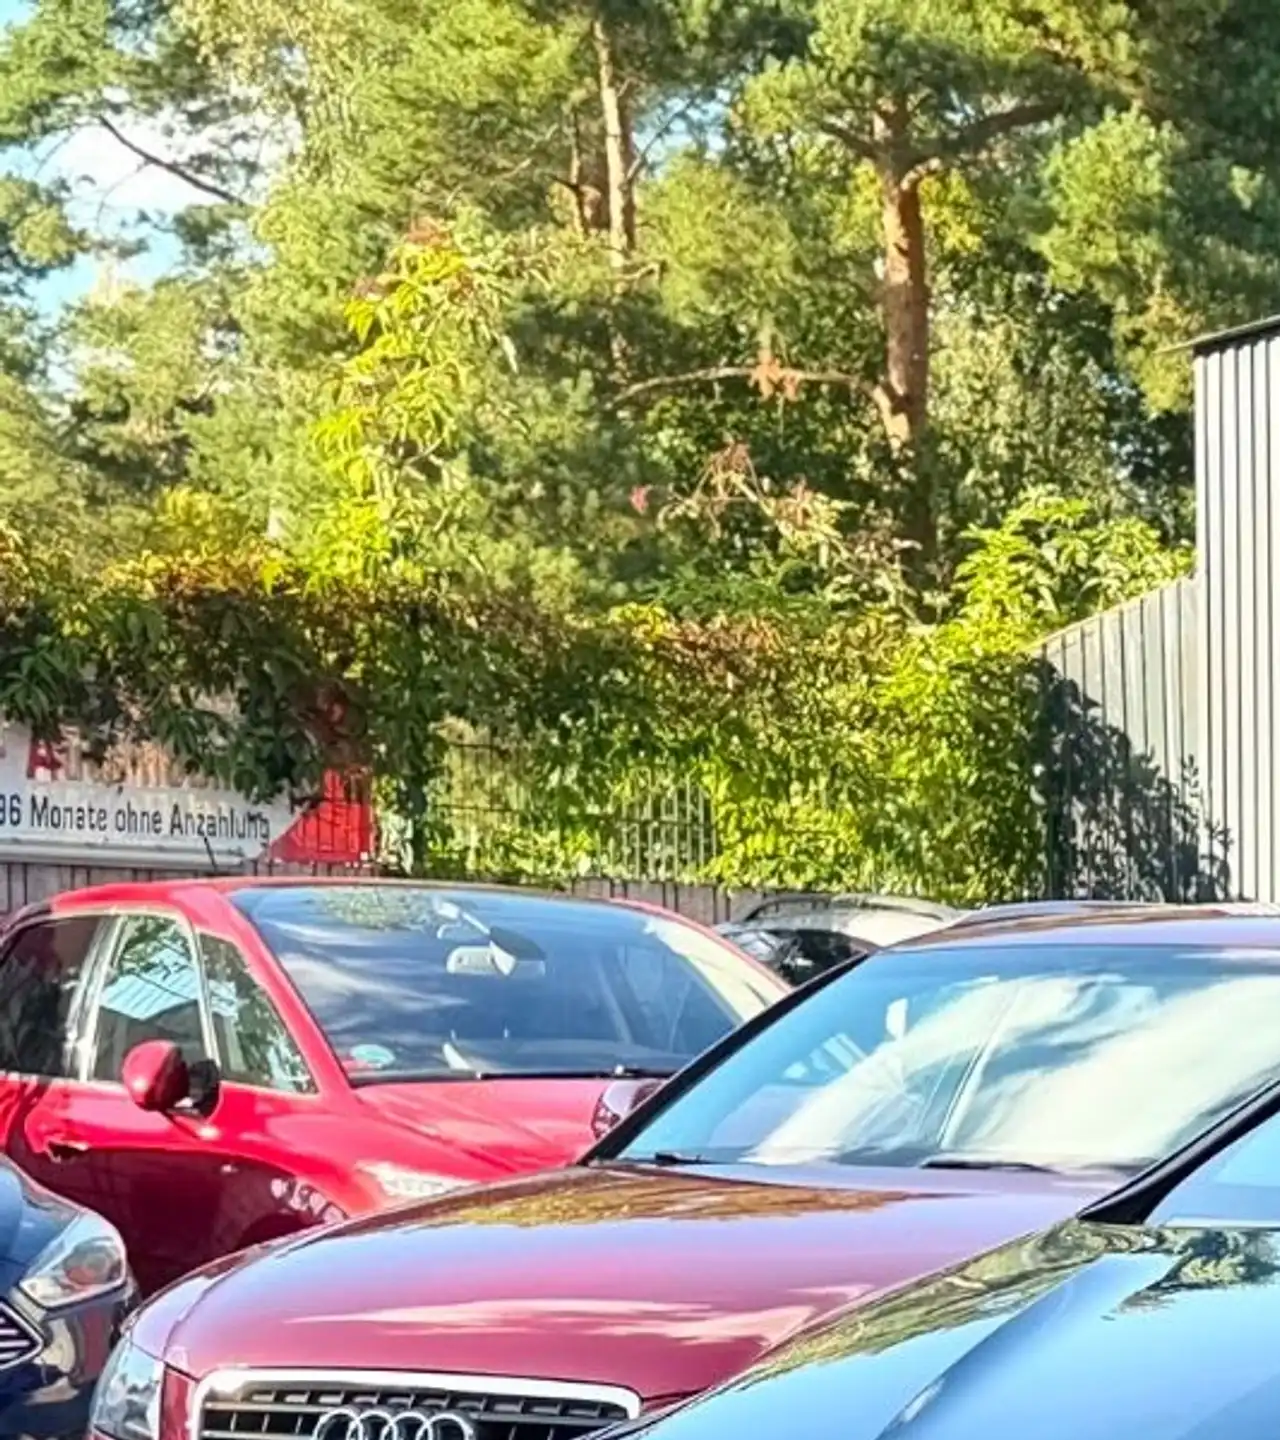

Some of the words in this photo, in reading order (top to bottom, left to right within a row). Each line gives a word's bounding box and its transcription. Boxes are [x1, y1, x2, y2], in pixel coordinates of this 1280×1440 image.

[31, 795, 108, 832] Monate
[115, 802, 162, 834] ohne
[170, 804, 270, 840] Anzahlung
